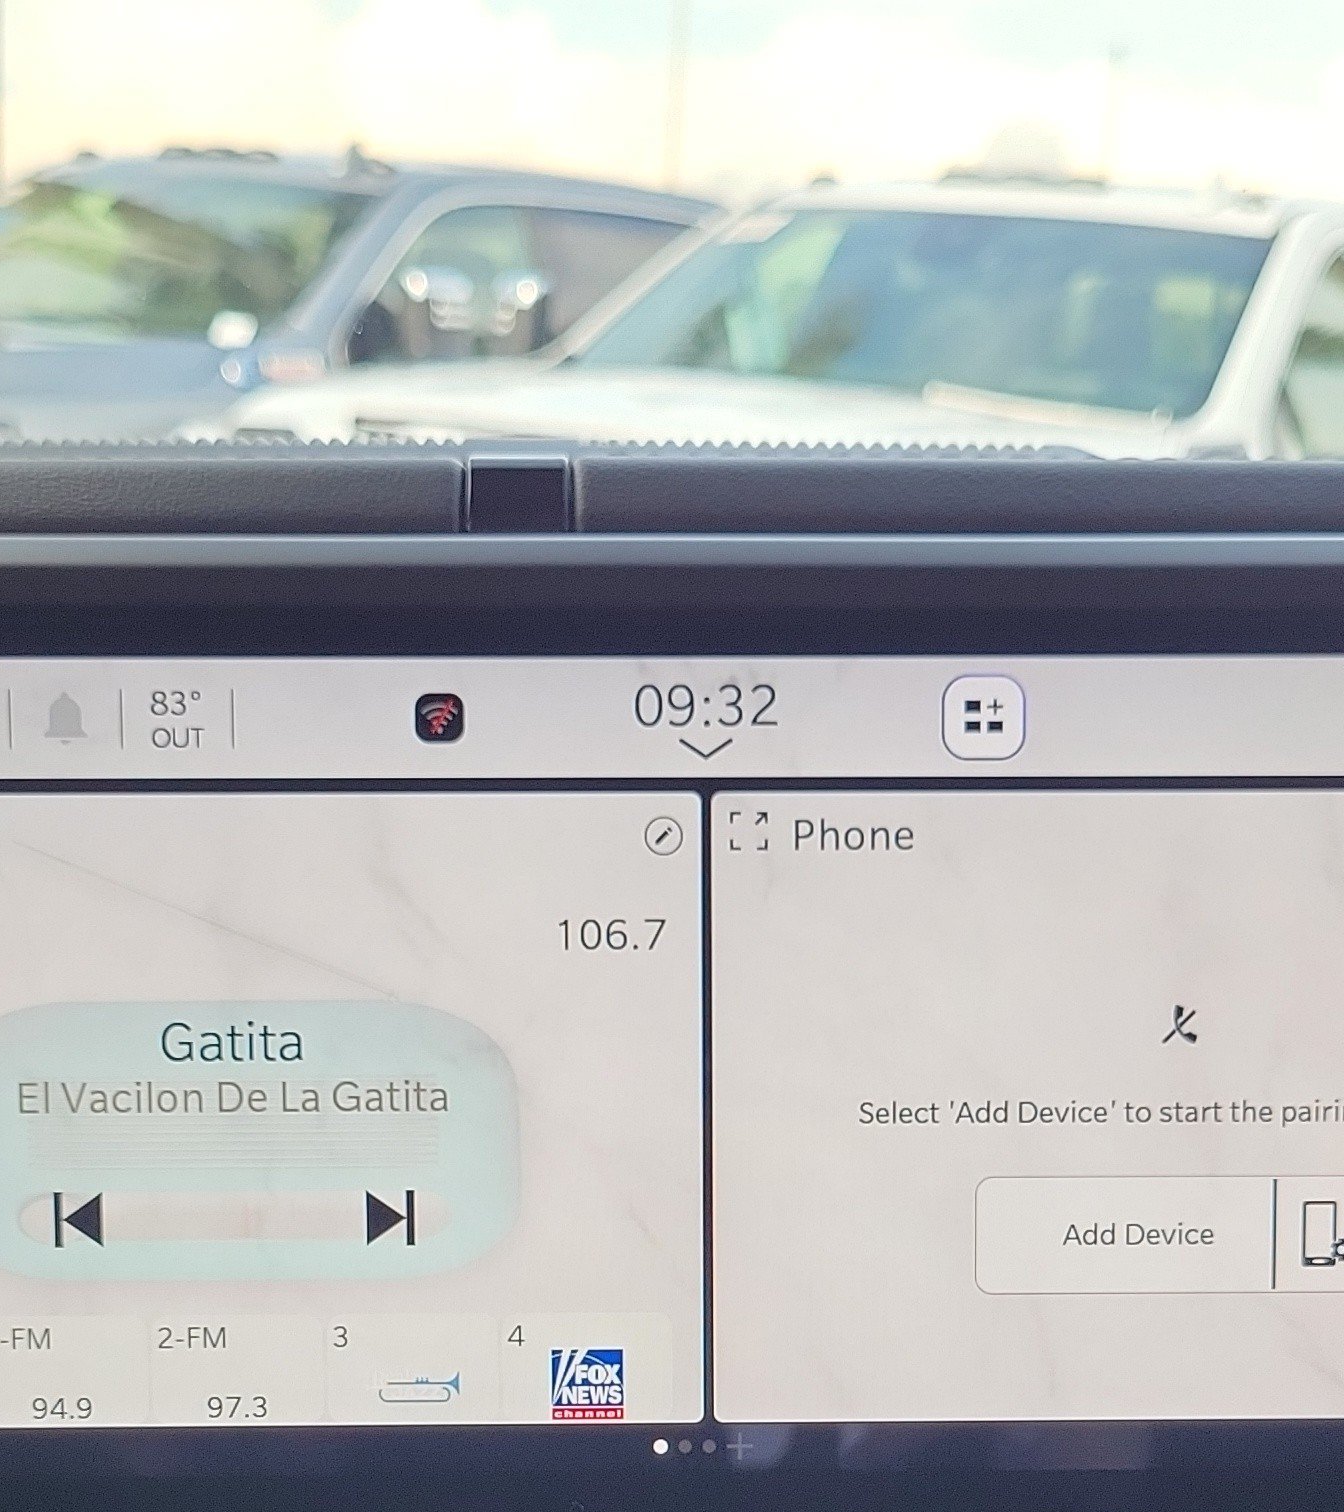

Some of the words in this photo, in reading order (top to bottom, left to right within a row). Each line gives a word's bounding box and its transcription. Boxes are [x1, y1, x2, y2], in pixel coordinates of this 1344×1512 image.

[150, 690, 202, 717] 83°
[634, 683, 779, 728] 09:32
[151, 727, 205, 749] OUT
[793, 818, 915, 852] Phone
[557, 918, 667, 951] 106.7
[160, 1020, 305, 1063] Gatita
[17, 1081, 51, 1115] El
[61, 1080, 204, 1114] Vacilon
[217, 1081, 268, 1113] De
[281, 1080, 320, 1112] La
[332, 1079, 450, 1113] Gatita
[859, 1101, 940, 1126] Select
[949, 1101, 1009, 1125] 'Add
[1017, 1101, 1117, 1125] Device'
[1124, 1102, 1152, 1124] to
[1159, 1102, 1223, 1124] start
[1230, 1100, 1273, 1124] the
[1062, 1223, 1116, 1247] Add
[1125, 1223, 1215, 1247] Device
[157, 1326, 227, 1350] 2-FM
[332, 1325, 349, 1348] 3
[507, 1324, 526, 1347] 4
[573, 1363, 622, 1385] FOX
[207, 1395, 269, 1419] 97.3
[560, 1385, 623, 1406] NEWS
[31, 1397, 93, 1420] 94.9
[553, 1409, 624, 1419] channel
